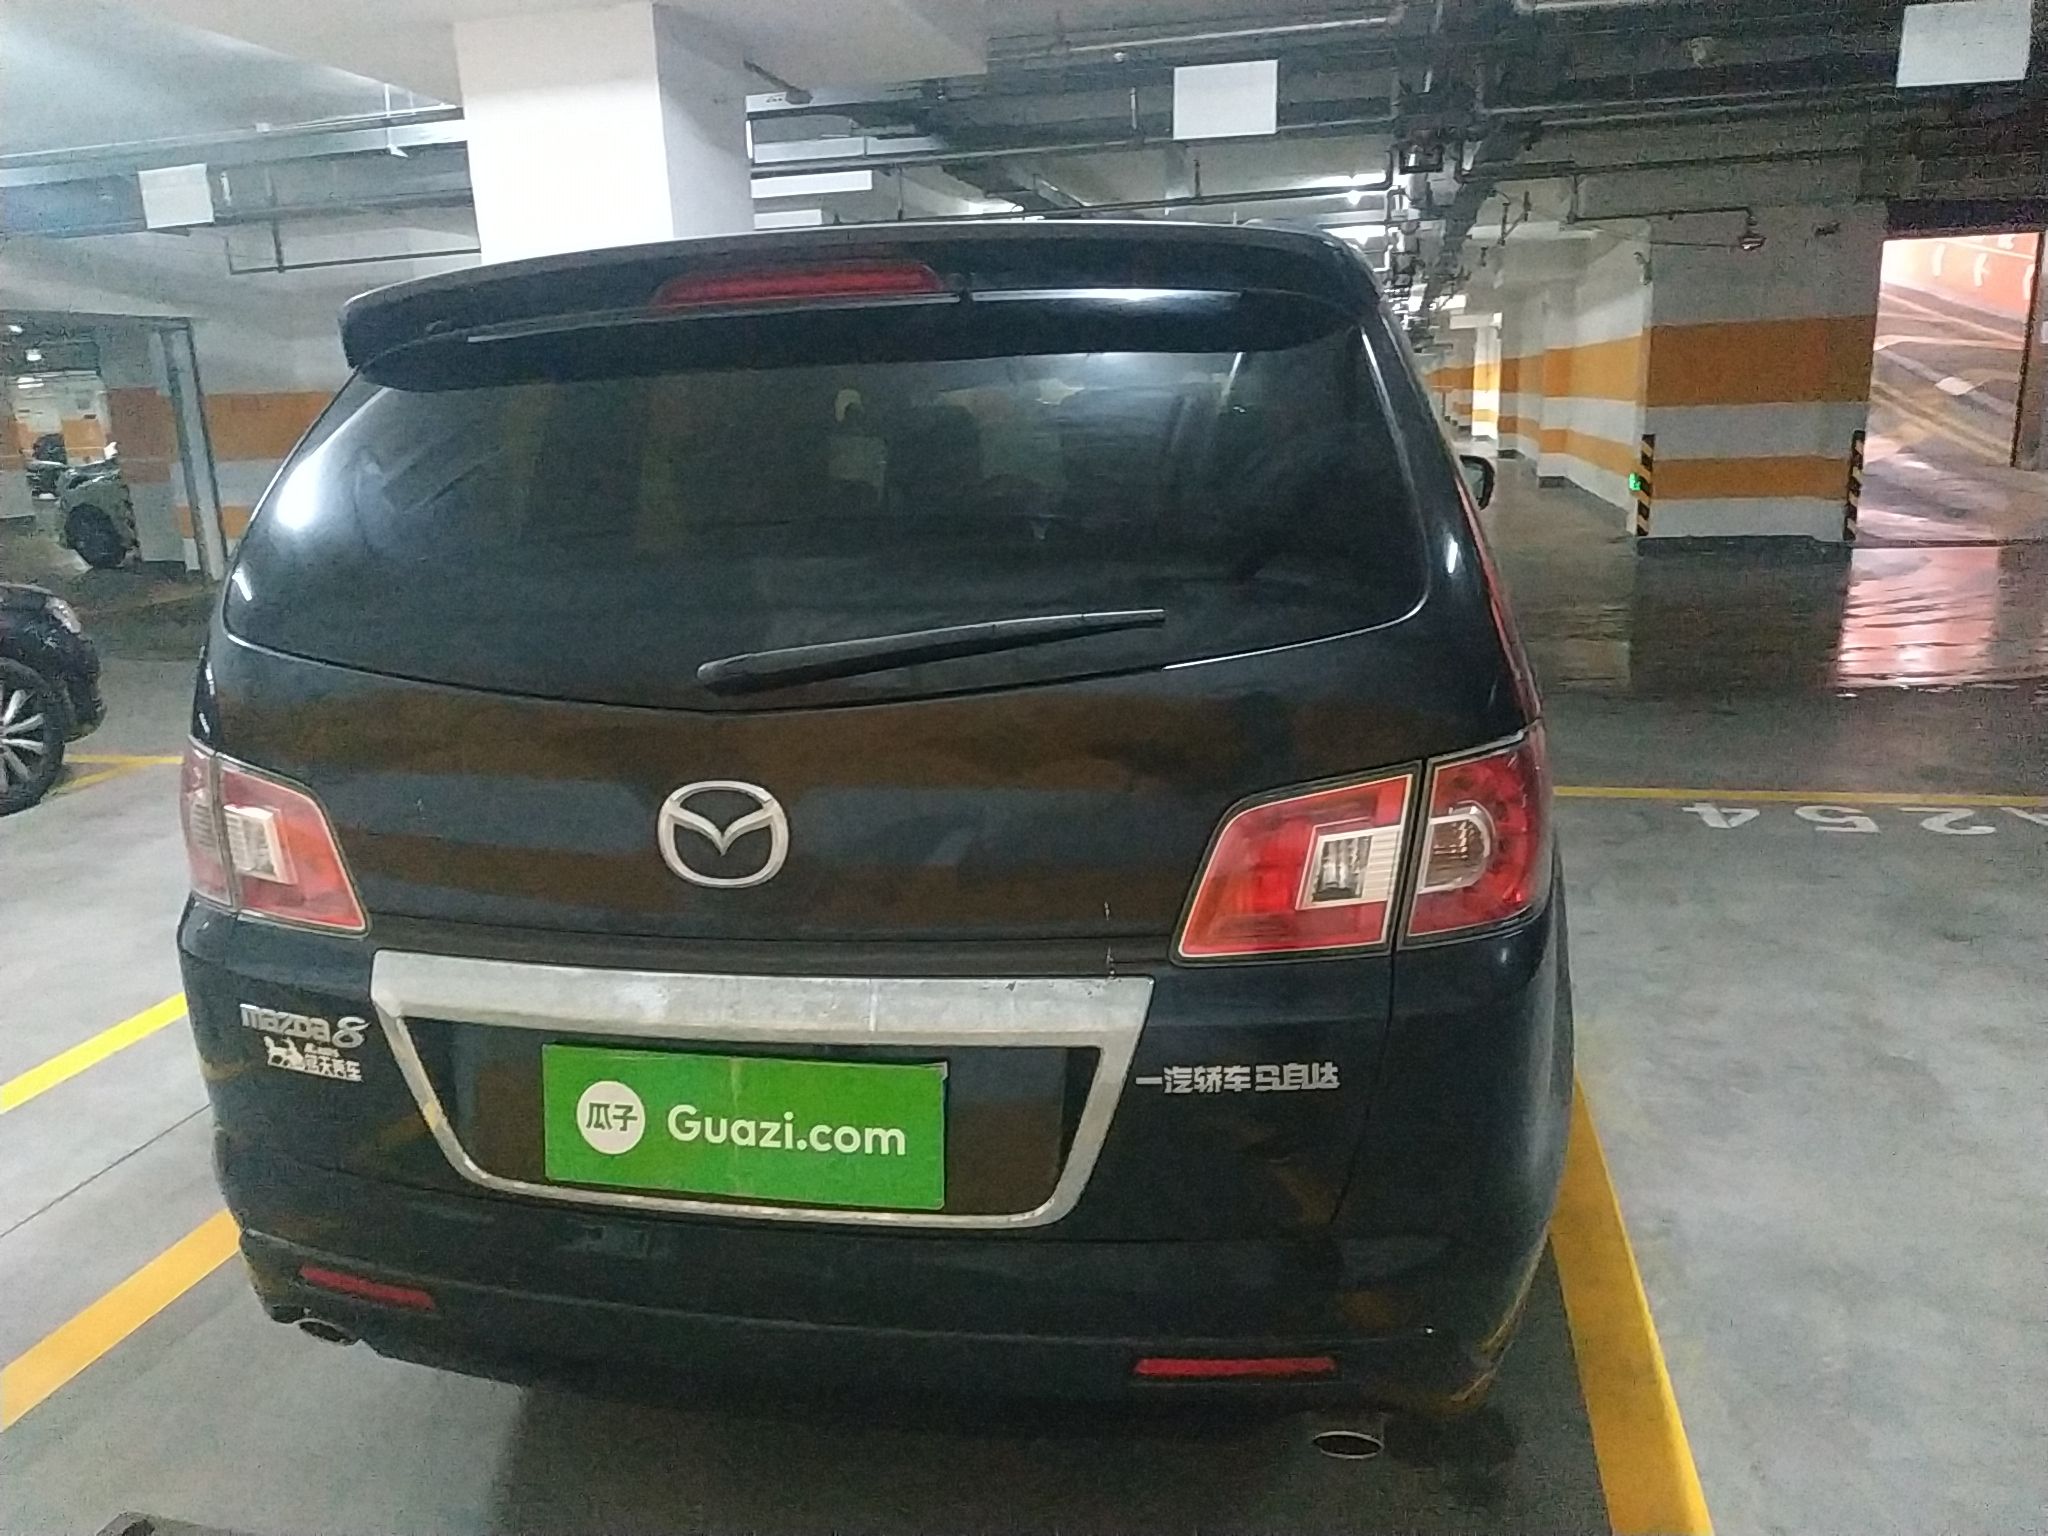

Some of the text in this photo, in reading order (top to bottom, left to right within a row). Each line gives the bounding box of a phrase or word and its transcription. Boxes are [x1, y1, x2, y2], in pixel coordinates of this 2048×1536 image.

[332, 1016, 371, 1048] 8
[584, 1102, 638, 1132] 瓜子
[667, 1104, 906, 1156] Guazi.com
